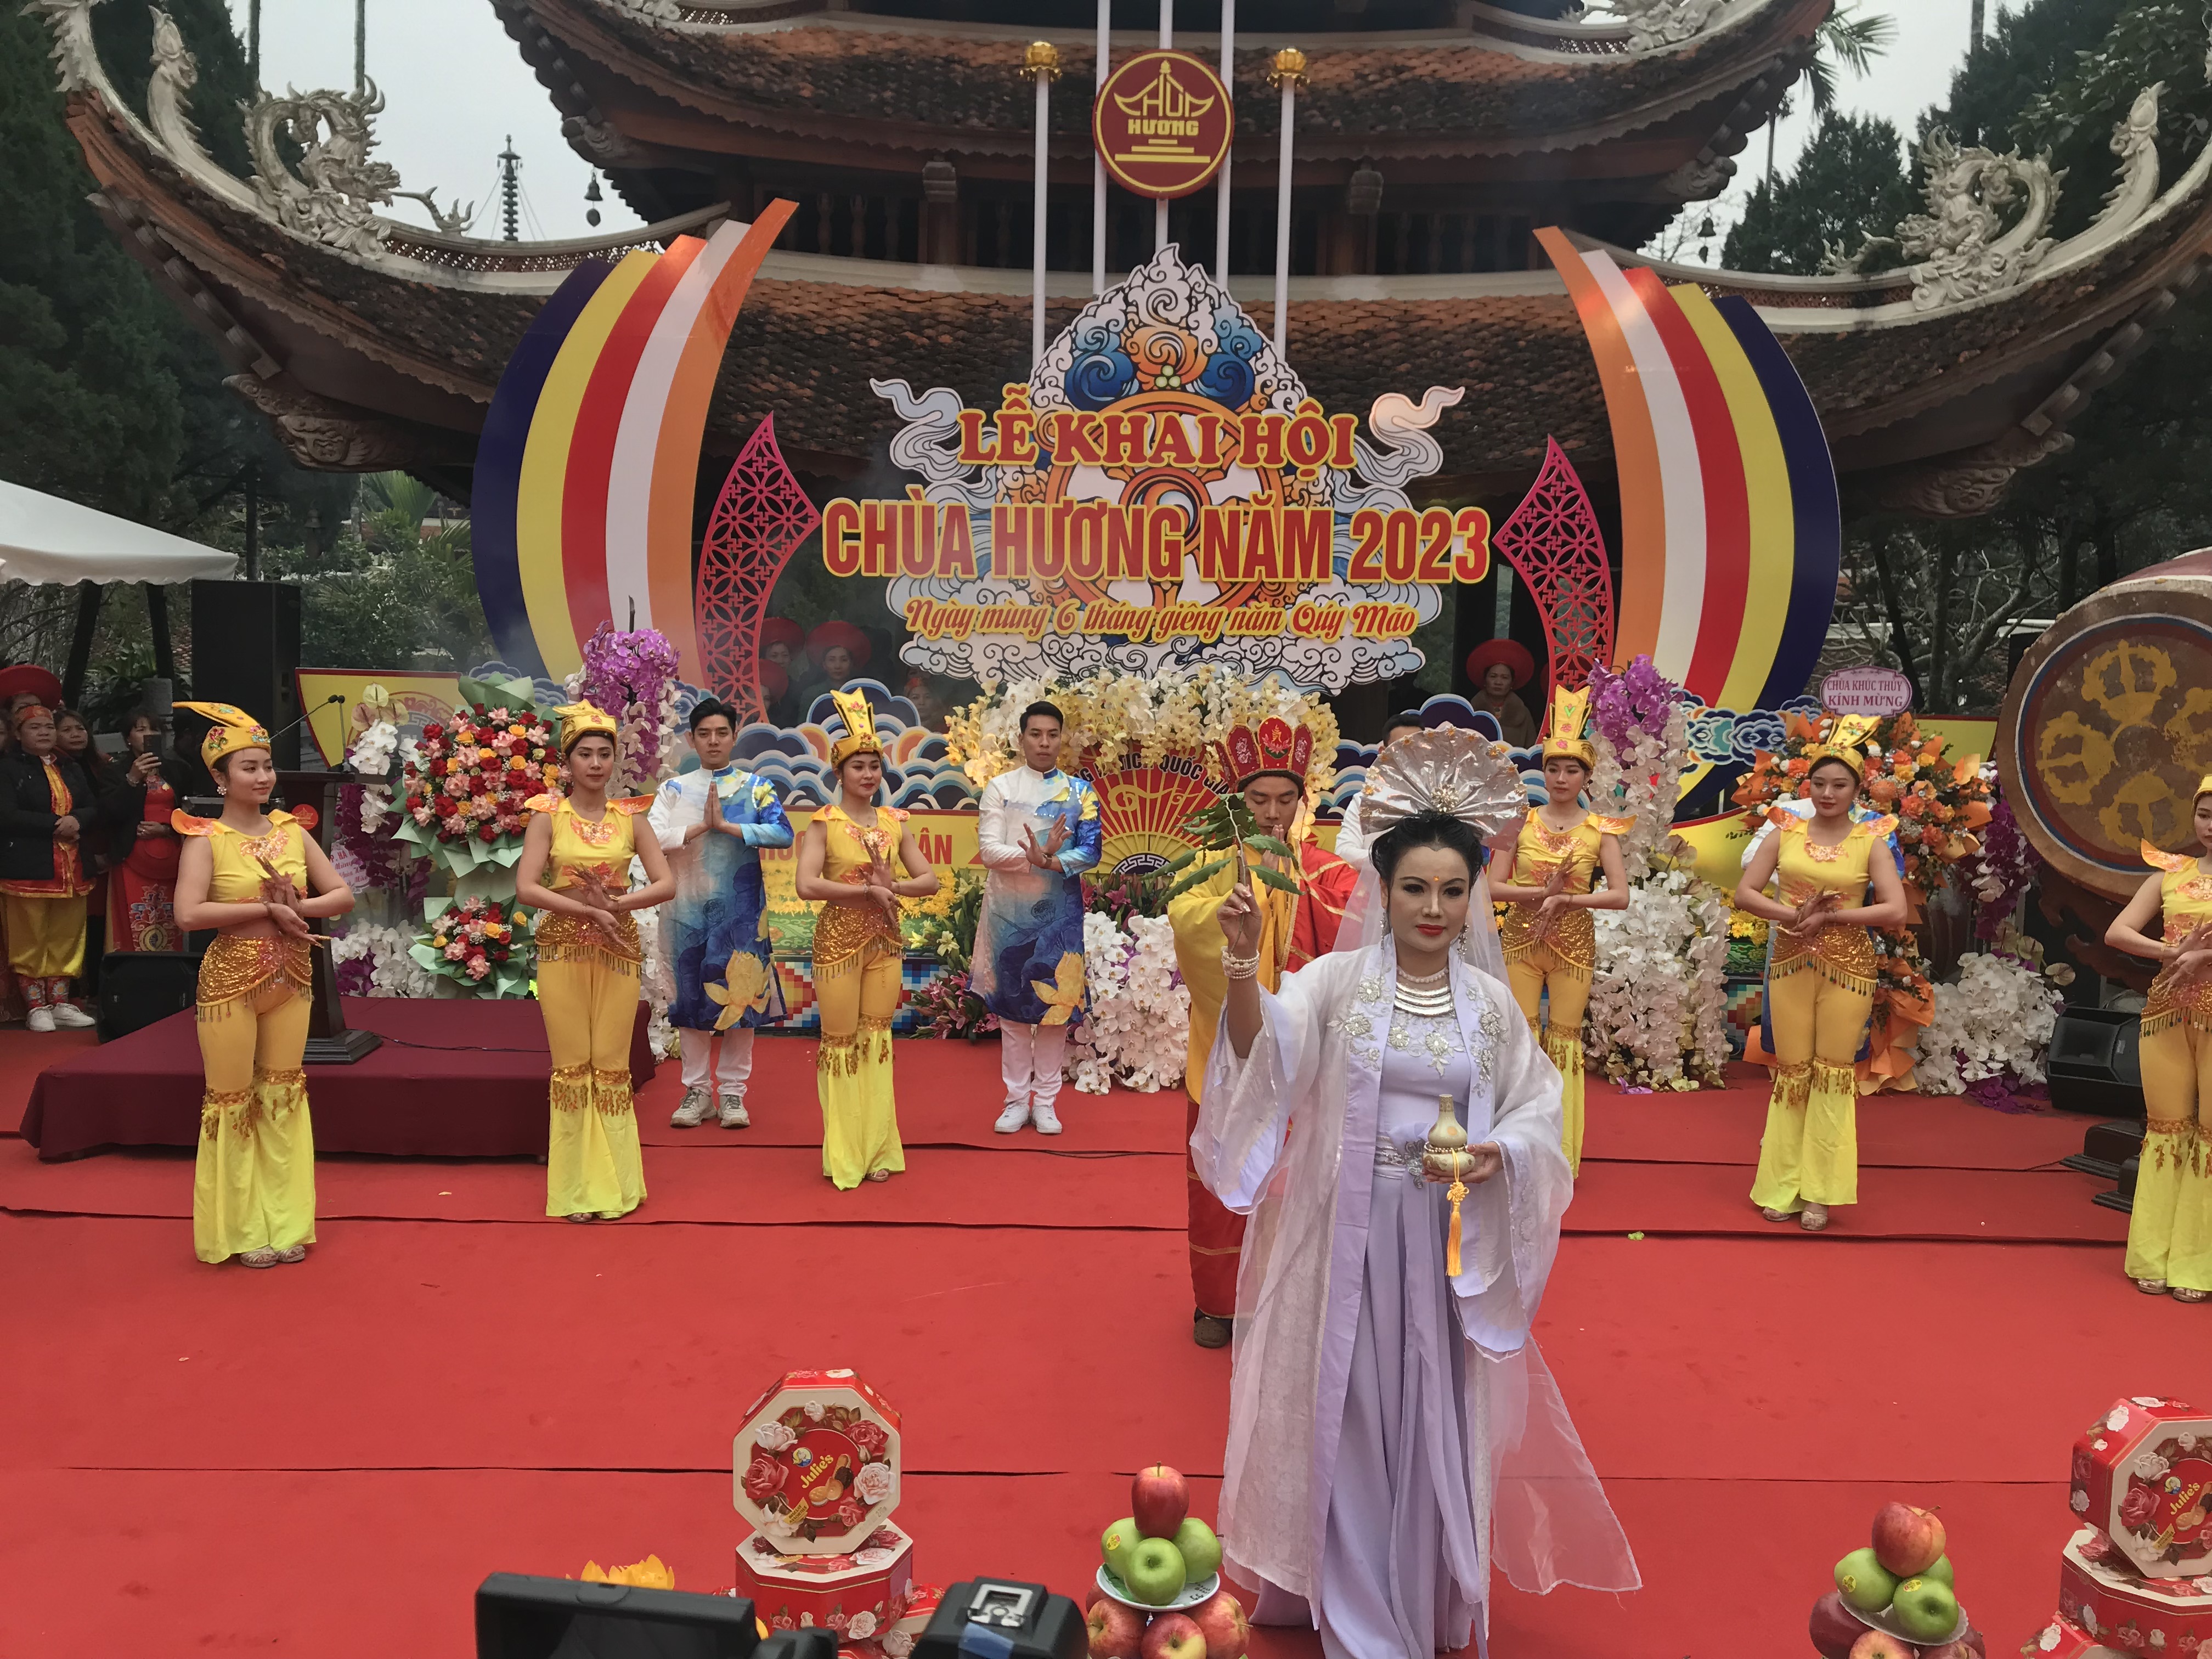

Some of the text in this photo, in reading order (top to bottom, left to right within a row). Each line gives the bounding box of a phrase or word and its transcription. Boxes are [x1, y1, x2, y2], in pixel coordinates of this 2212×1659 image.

[958, 386, 1358, 478] LỄ KHAI HỘI
[826, 488, 1489, 581] CHÙA HƯƠNG NĂM 2023
[906, 599, 975, 637] Ngày
[979, 601, 1048, 636] mùng
[1056, 602, 1080, 630] 6
[1084, 601, 1152, 638] tháng
[1155, 604, 1224, 639] giêng
[1228, 605, 1283, 631] năm
[1352, 605, 1416, 636] Mão
[1828, 692, 1903, 707] KÍNH MỪNG
[1852, 678, 1876, 691] KHÚC
[1159, 754, 1203, 780] QUỐC
[800, 1454, 834, 1489] Julie's
[2170, 1482, 2200, 1515] Julie's
